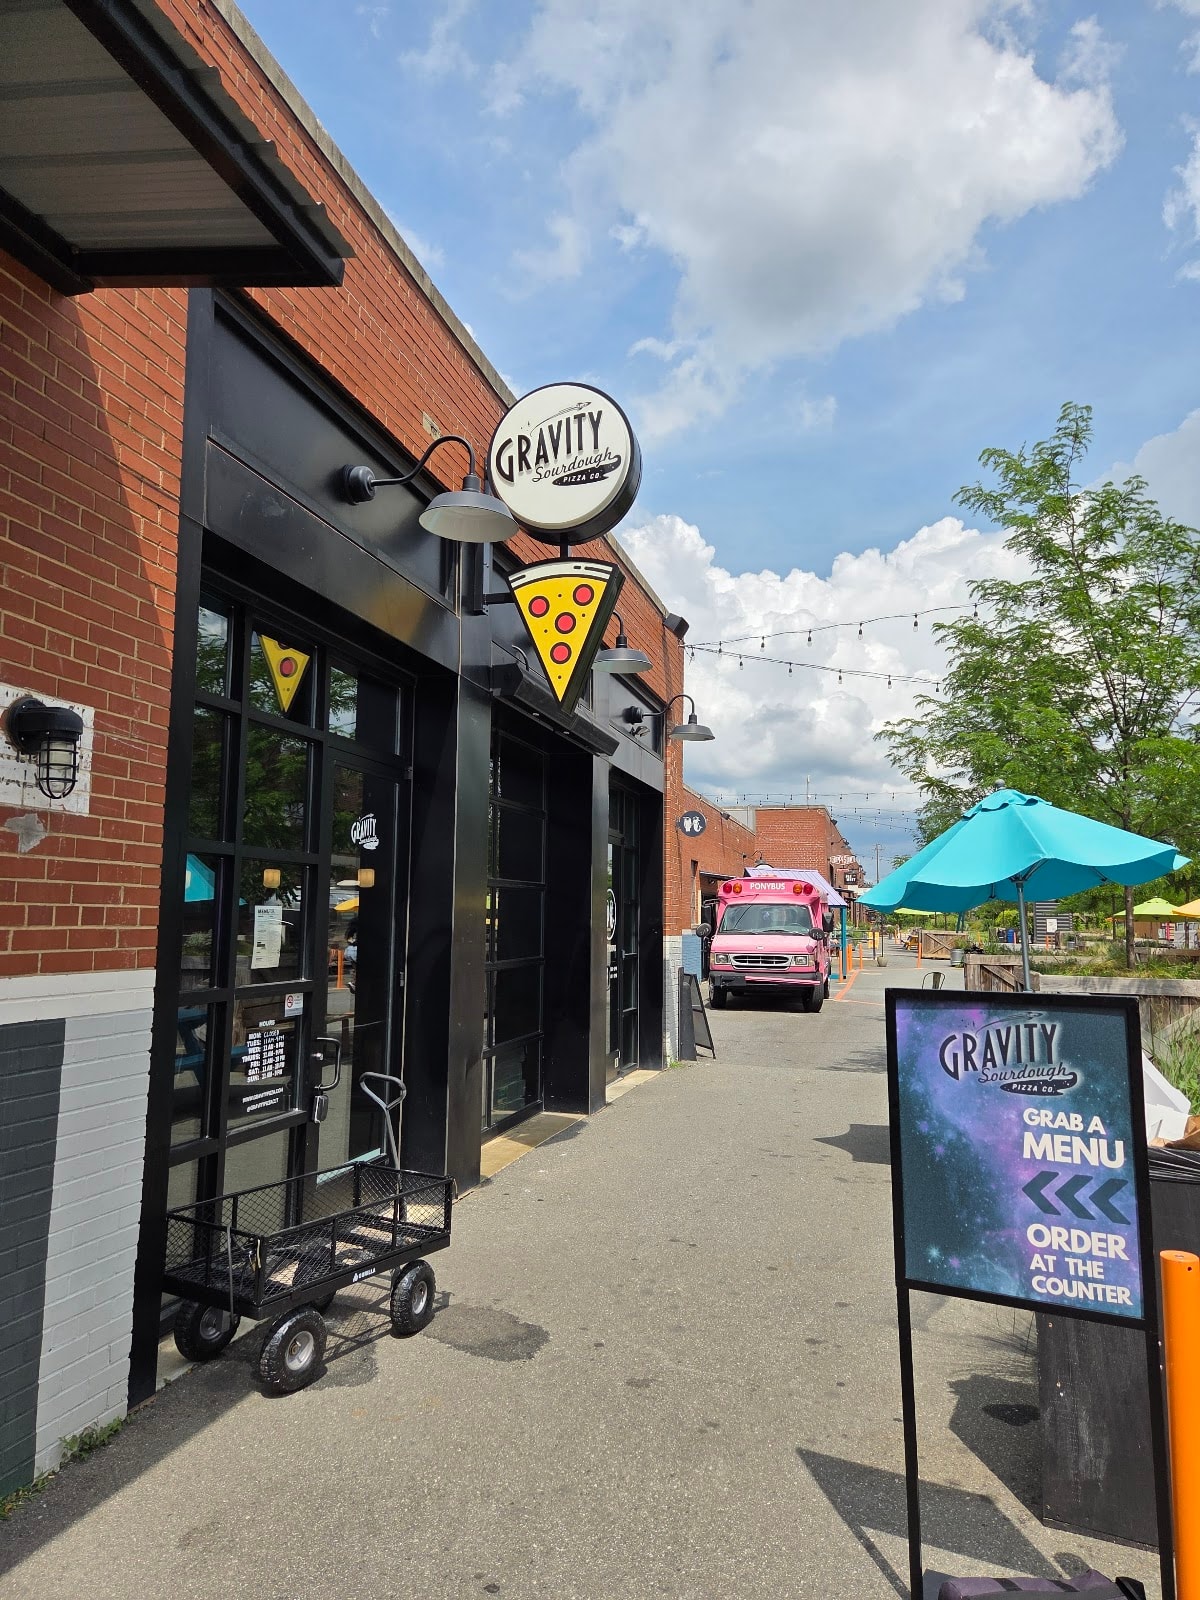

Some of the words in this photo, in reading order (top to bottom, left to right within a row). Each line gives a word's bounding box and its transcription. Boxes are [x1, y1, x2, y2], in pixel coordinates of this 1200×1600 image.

[495, 410, 603, 484] GRAVITY
[531, 447, 617, 483] Sourdough
[563, 475, 586, 483] PIZZA
[351, 818, 377, 843] GRAVITY
[750, 882, 785, 890] PONYBUS
[939, 1023, 1057, 1080] GRAVITY
[978, 1062, 1067, 1084] Sourdough
[1011, 1083, 1038, 1092] PIZZA
[1022, 1107, 1084, 1132] GRAB
[1087, 1115, 1106, 1135] A
[1022, 1131, 1125, 1169] MENU
[1026, 1223, 1130, 1261] ORDER
[1029, 1253, 1057, 1273] AT
[1064, 1257, 1105, 1280] THE
[1031, 1275, 1133, 1306] COUNTER
